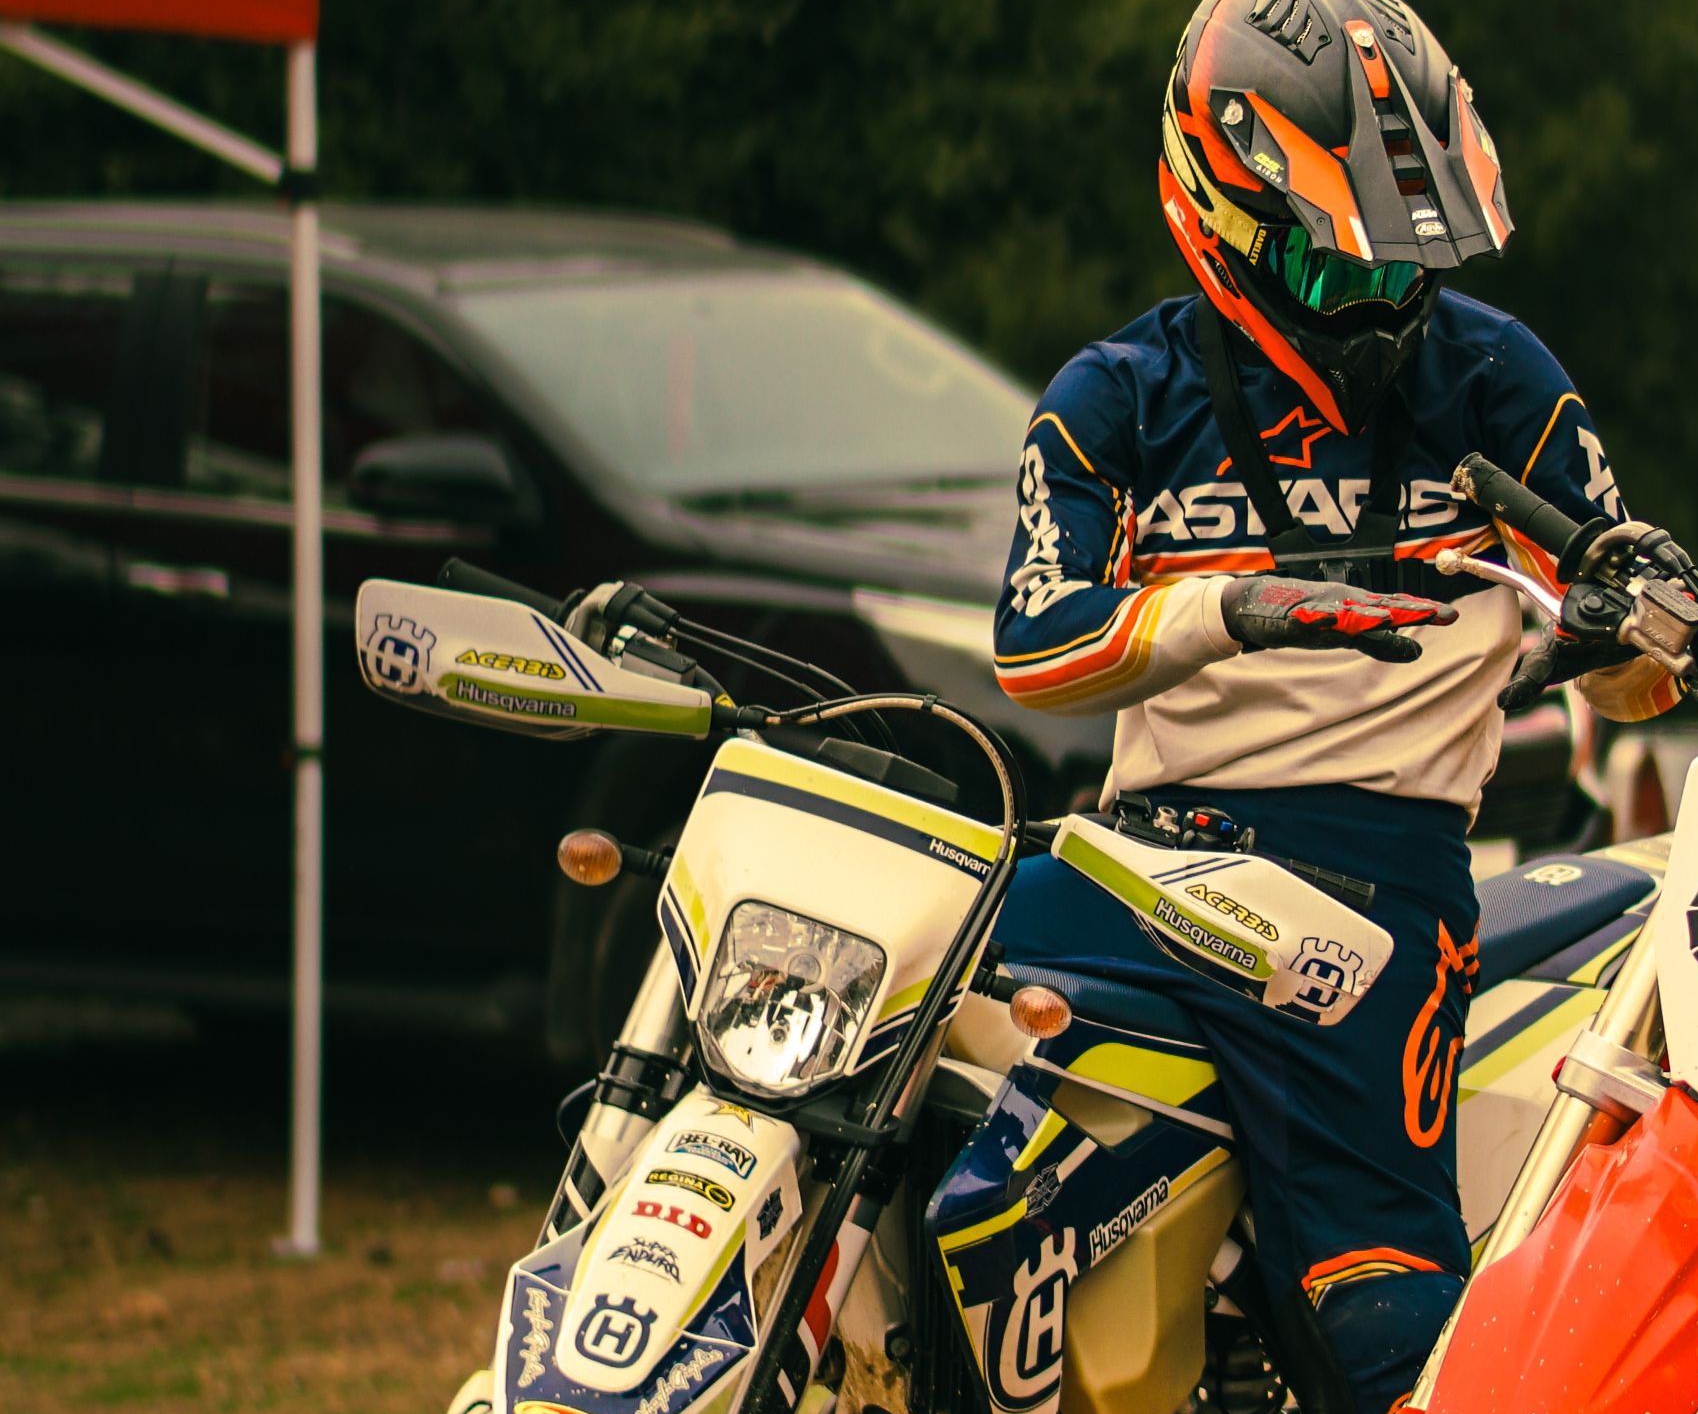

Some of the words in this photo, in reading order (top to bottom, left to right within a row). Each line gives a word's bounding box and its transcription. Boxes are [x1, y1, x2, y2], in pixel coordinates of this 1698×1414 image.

[456, 679, 577, 719] Husqvarna
[1154, 897, 1256, 971] Husqvarna
[674, 1133, 752, 1172] BEL-RAY
[648, 1171, 706, 1191] REGINA
[1089, 1175, 1170, 1265] Husqvarna
